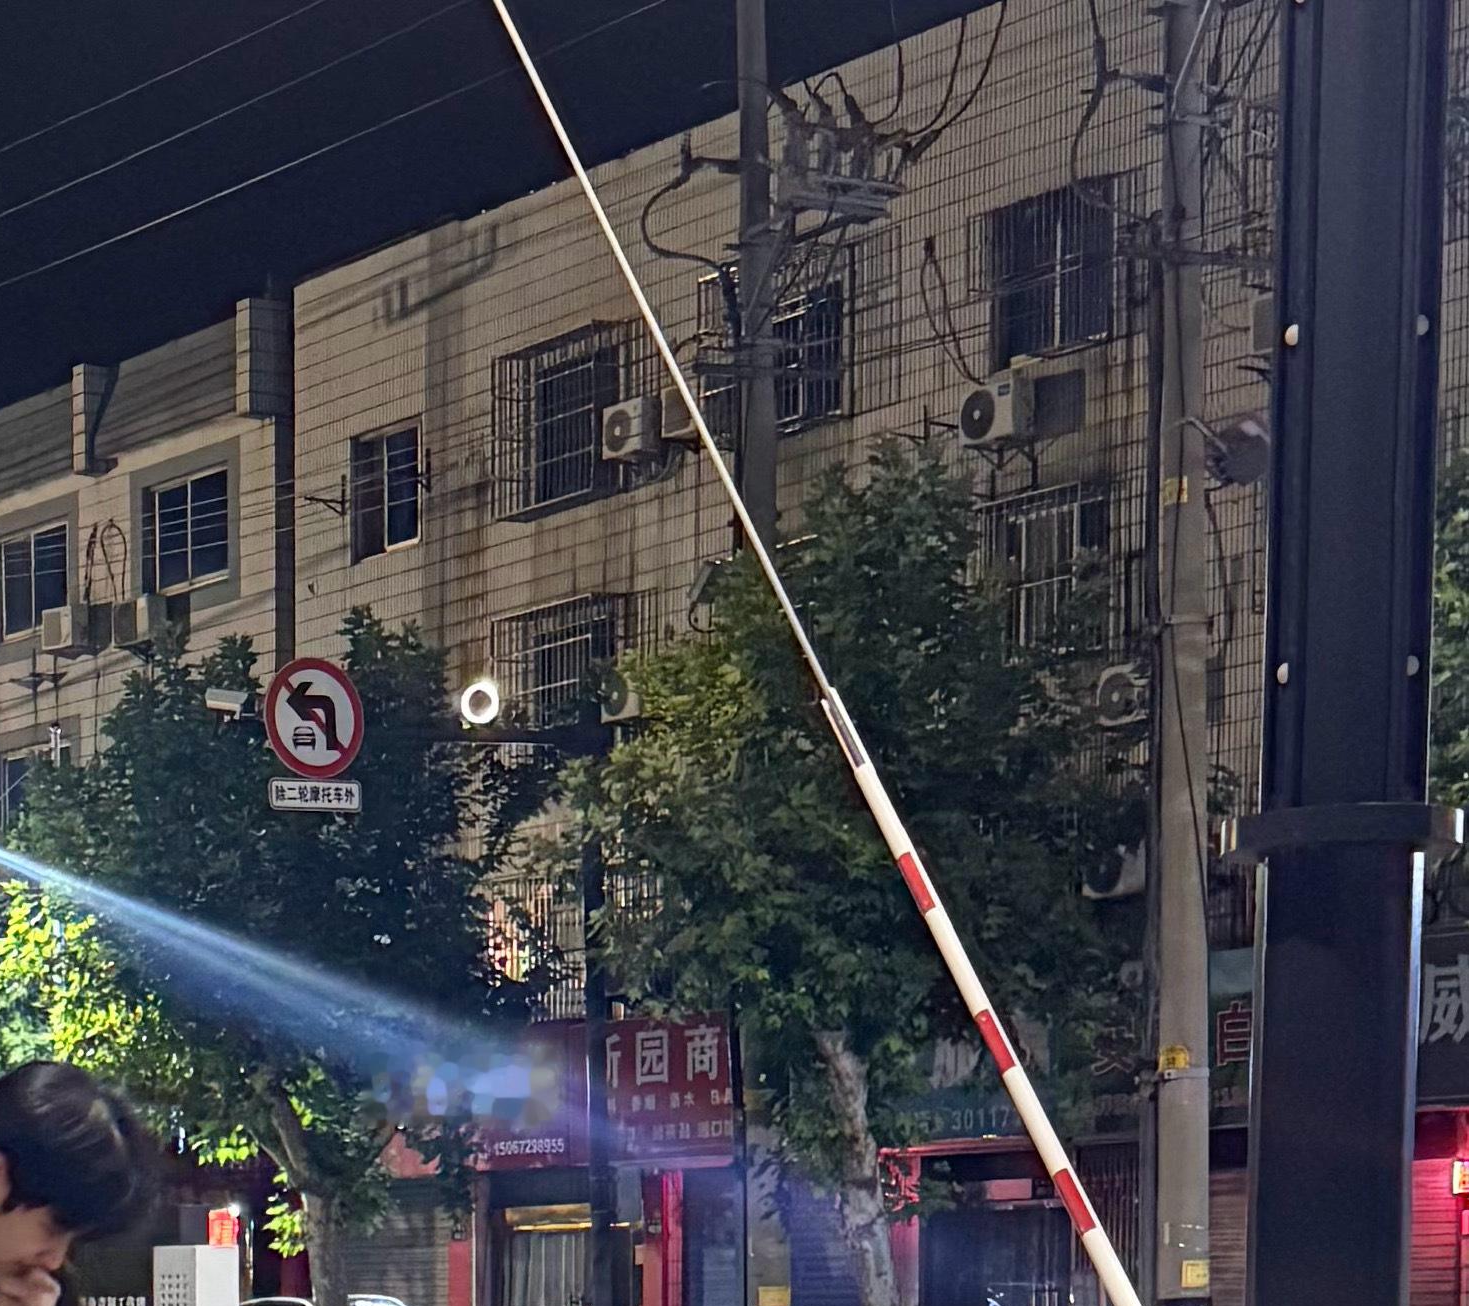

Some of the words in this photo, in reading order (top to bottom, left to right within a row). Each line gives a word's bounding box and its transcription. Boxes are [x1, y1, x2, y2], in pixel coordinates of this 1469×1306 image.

[275, 784, 355, 805] 除二轮摩托车外
